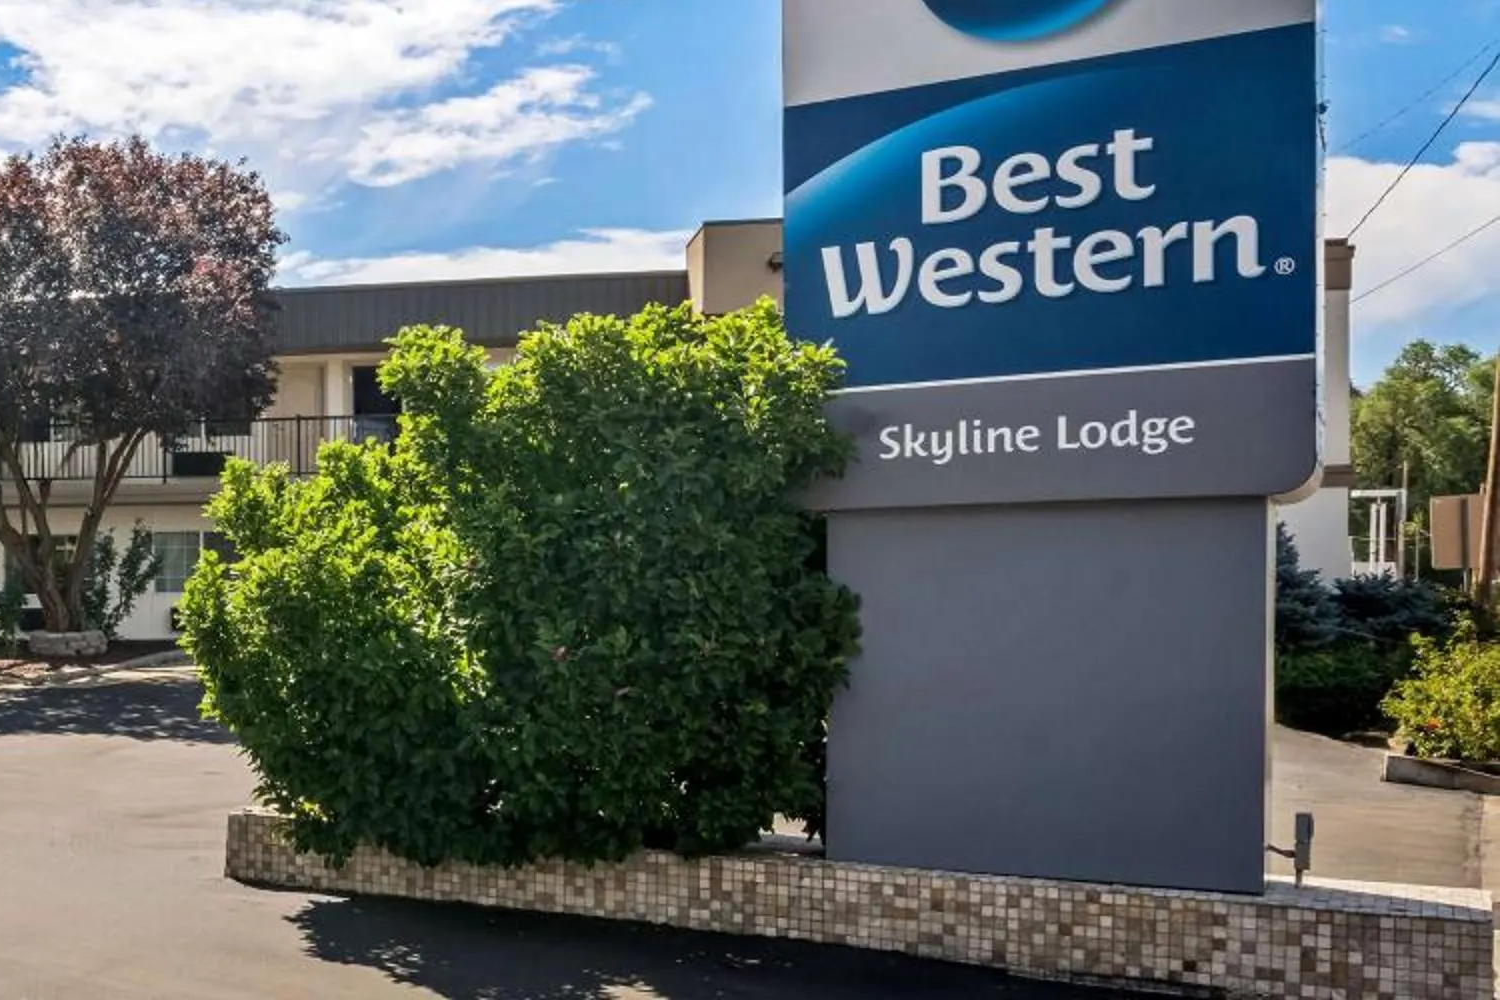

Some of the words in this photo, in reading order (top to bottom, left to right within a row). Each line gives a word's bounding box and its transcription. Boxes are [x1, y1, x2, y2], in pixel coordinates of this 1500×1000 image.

[920, 128, 1157, 225] Best
[878, 419, 1042, 466] Skyline
[1056, 408, 1197, 456] Lodge
